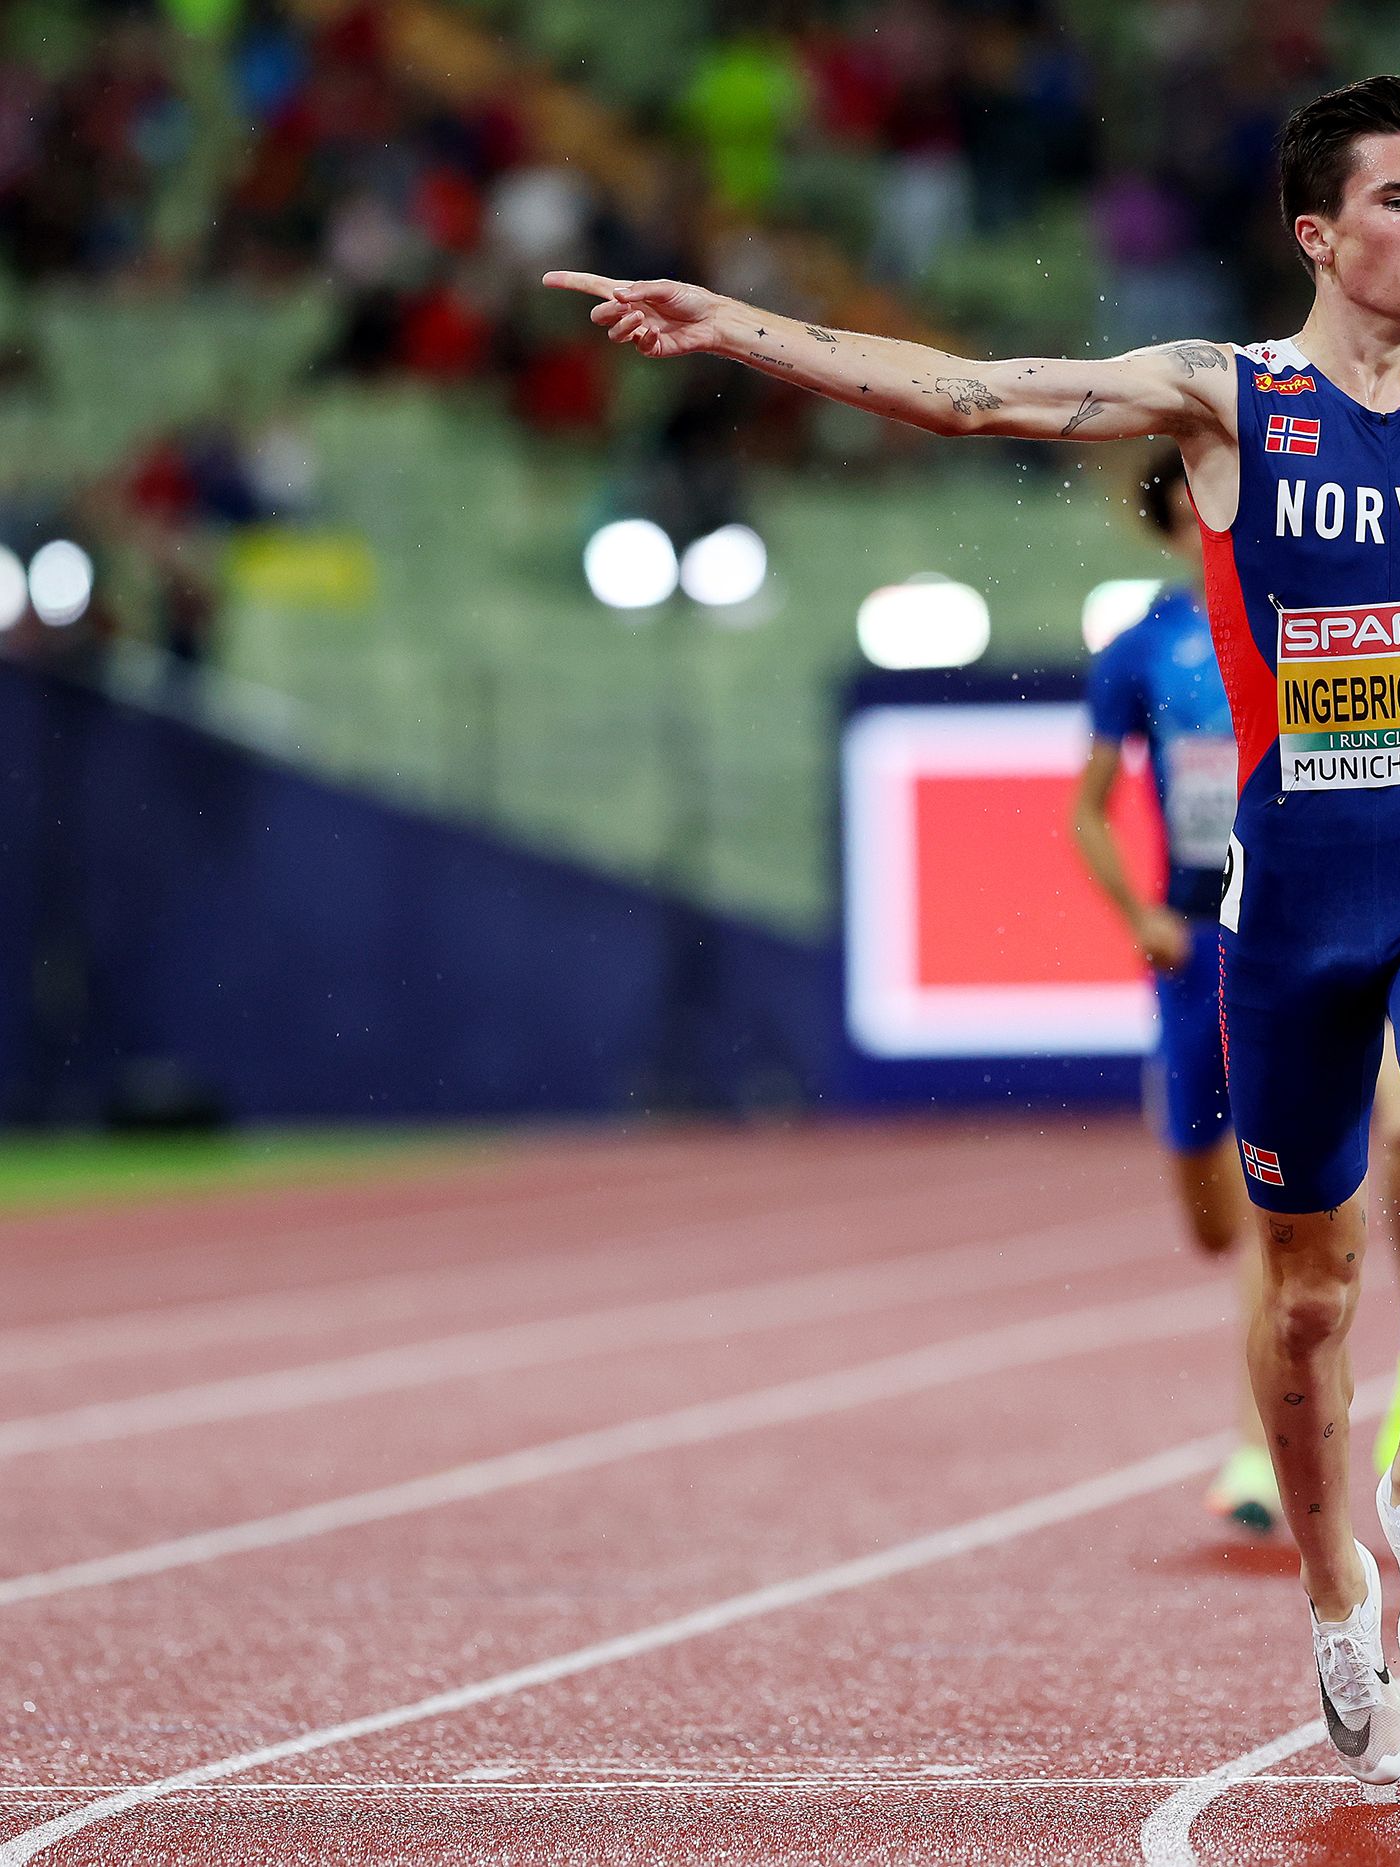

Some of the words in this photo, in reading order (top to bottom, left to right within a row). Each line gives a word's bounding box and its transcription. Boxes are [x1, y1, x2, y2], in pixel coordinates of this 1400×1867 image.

[1274, 379, 1311, 391] XTRA
[1329, 734, 1334, 749] I
[1340, 732, 1378, 748] RUN
